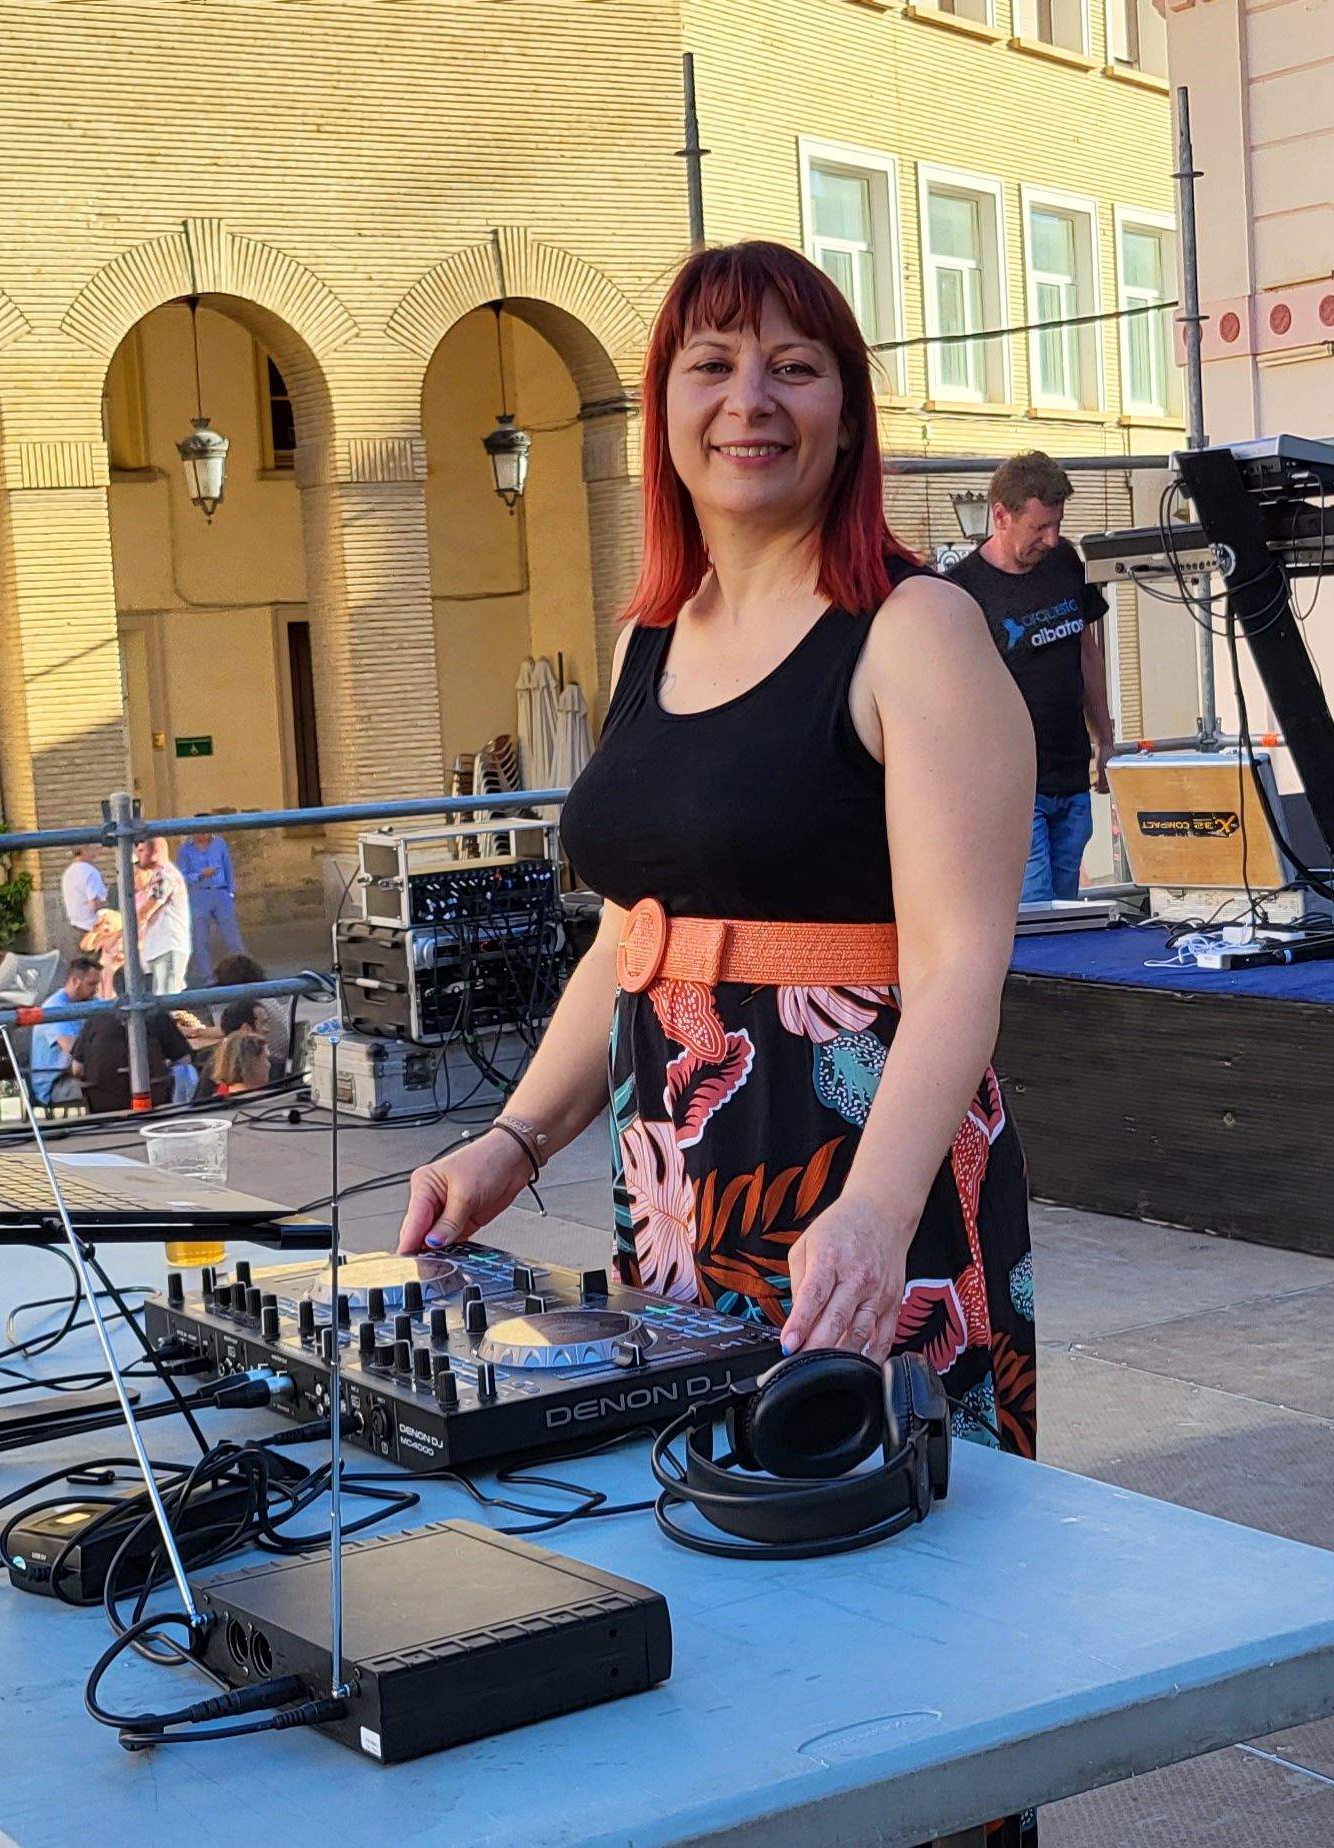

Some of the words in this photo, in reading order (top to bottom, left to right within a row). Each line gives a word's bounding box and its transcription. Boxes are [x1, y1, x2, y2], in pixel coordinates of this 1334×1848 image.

[546, 1382, 678, 1428] DENON
[686, 1370, 732, 1397] DJ
[399, 1422, 431, 1445] DENON
[431, 1438, 444, 1449] DJ
[400, 1436, 435, 1456] MC4000
